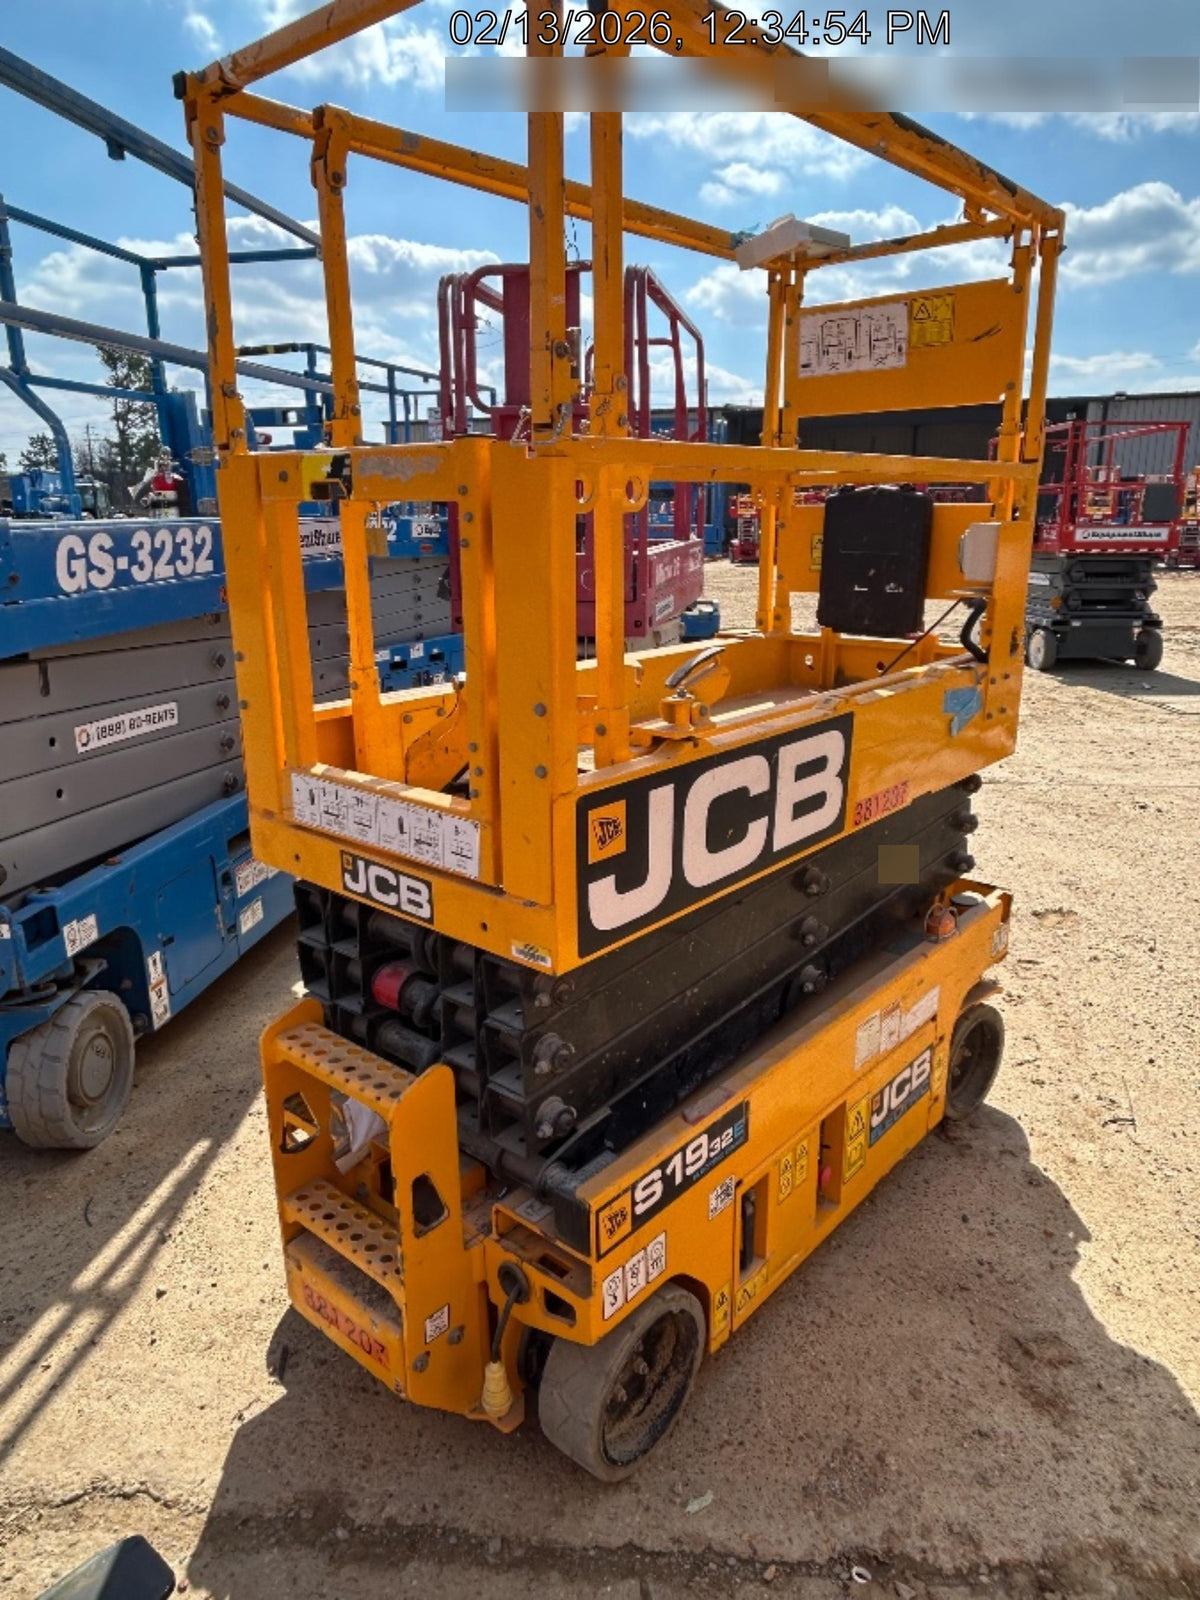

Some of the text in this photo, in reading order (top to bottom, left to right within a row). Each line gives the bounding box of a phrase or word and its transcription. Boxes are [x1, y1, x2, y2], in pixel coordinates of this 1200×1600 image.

[56, 526, 214, 593] GS-3232
[588, 730, 845, 931] JCB
[344, 859, 432, 920] JCB
[871, 1049, 931, 1128] JCB
